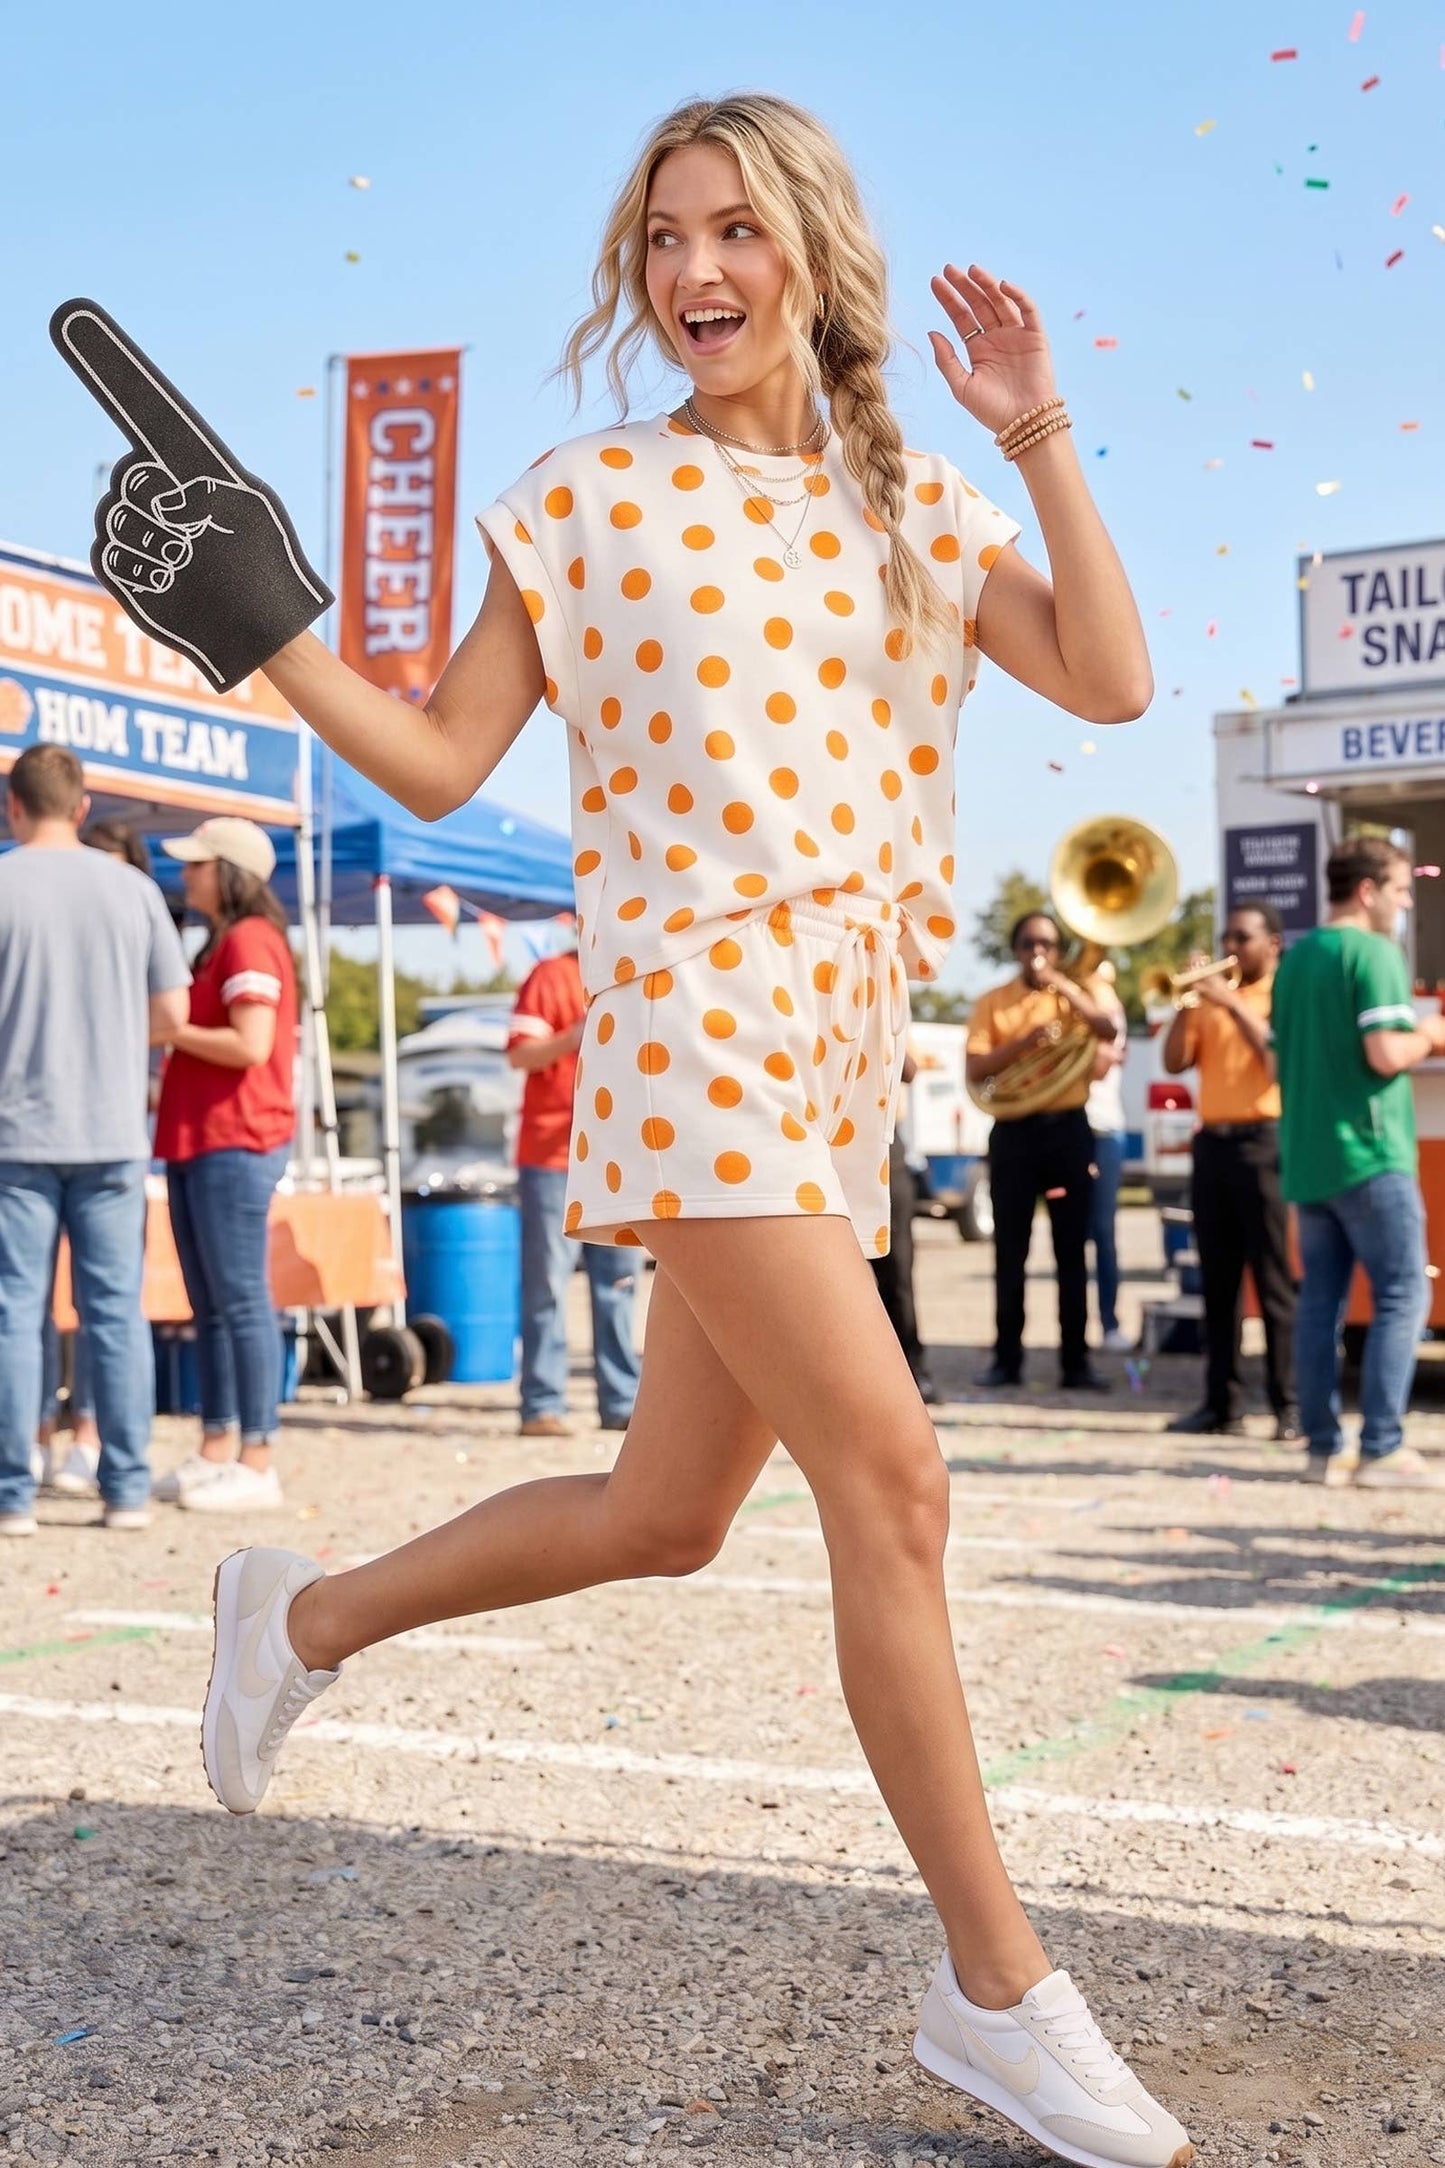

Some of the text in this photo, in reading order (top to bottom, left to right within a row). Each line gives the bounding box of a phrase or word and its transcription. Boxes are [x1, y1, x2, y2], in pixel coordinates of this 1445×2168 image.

[364, 406, 437, 657] CHEER
[1341, 566, 1445, 615] TAIL
[114, 612, 253, 701] TE
[35, 687, 249, 782] HOM TEAM
